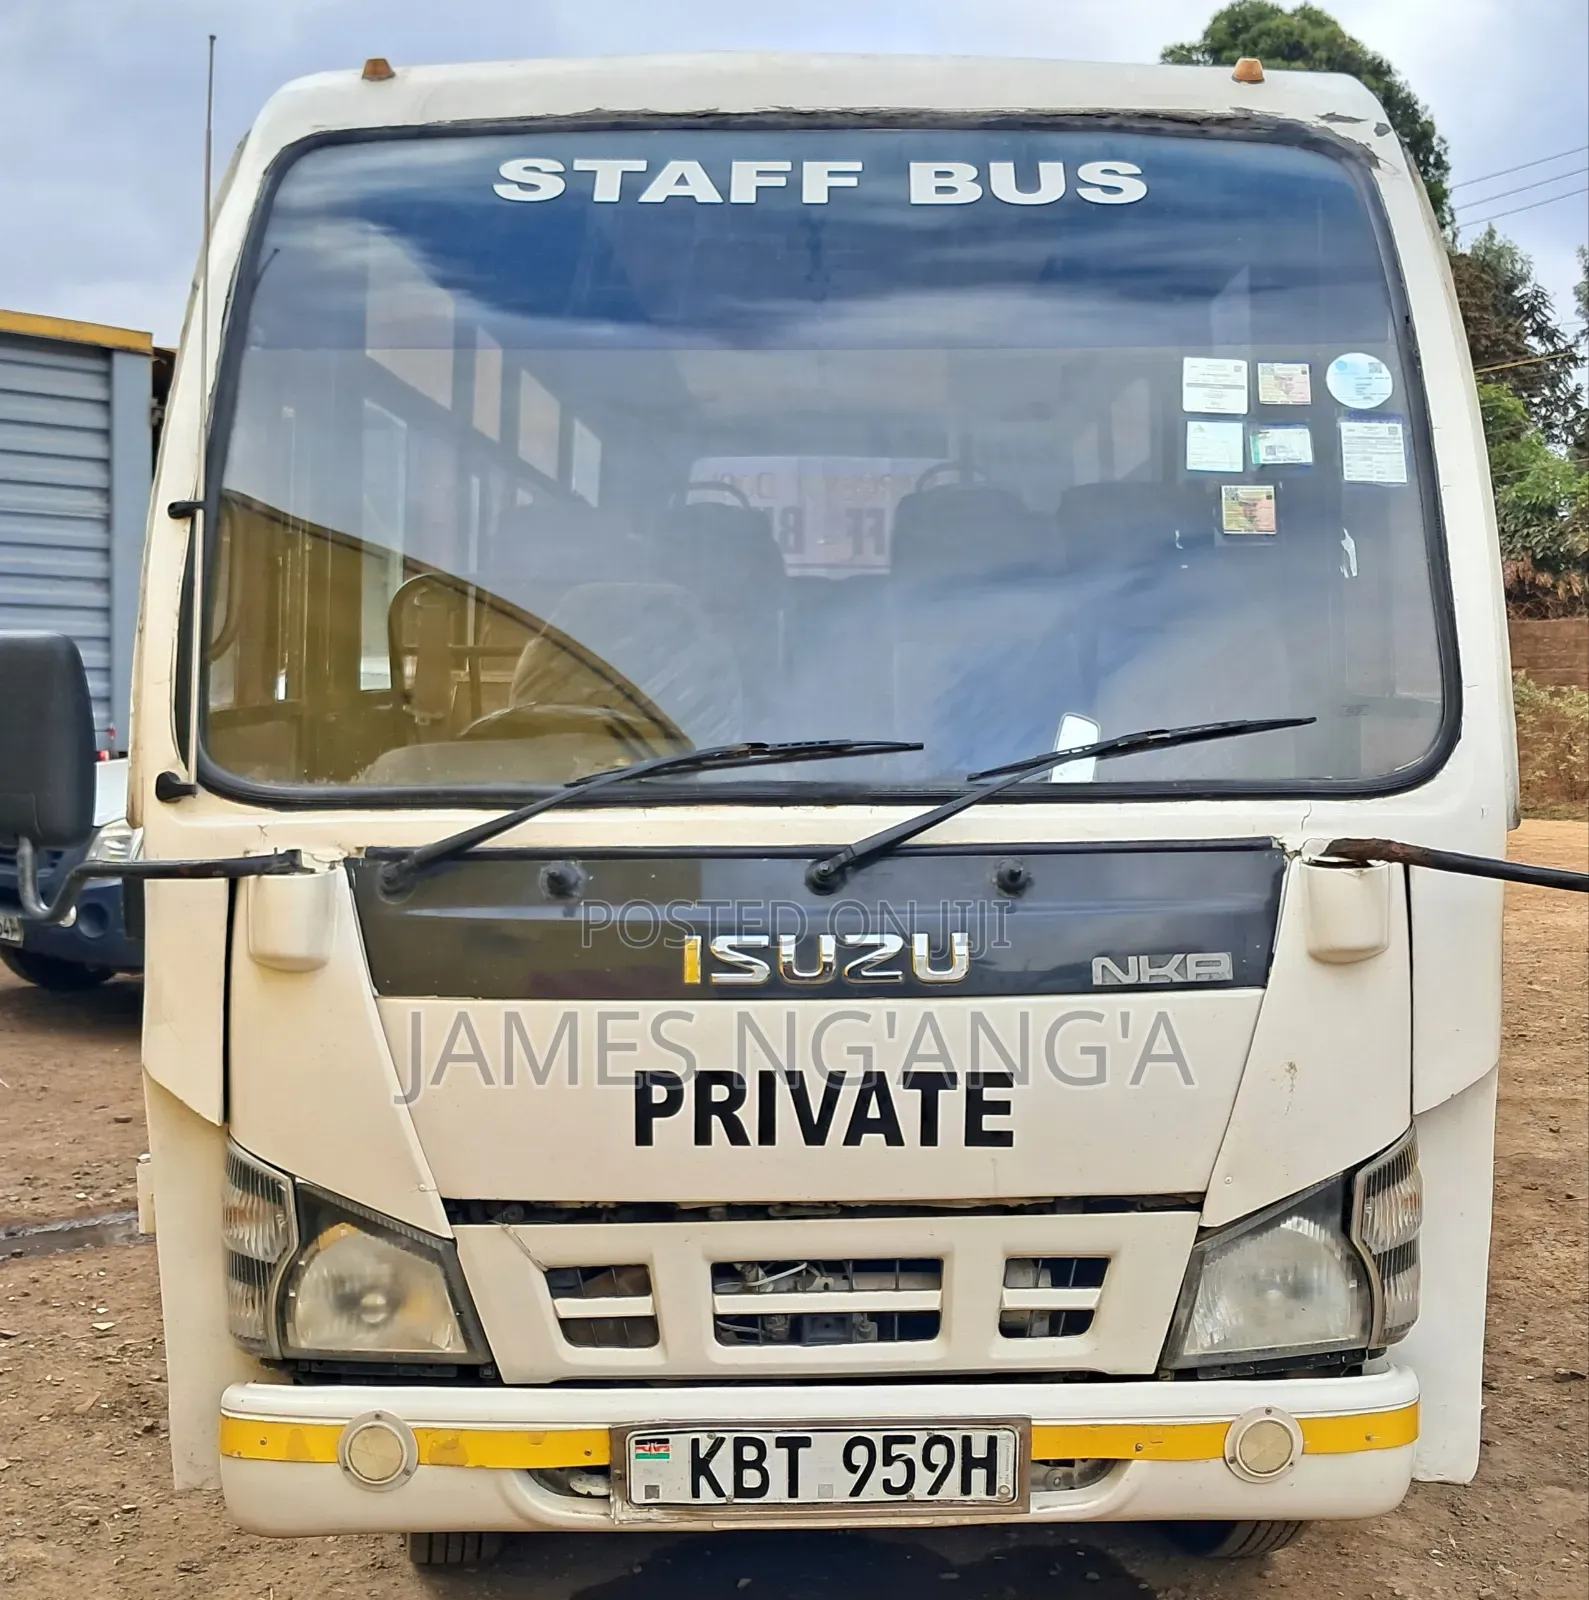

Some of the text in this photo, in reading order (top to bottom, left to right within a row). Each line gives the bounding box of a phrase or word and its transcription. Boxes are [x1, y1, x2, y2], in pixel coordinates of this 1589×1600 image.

[493, 158, 1149, 206] STAFF BUS
[683, 931, 971, 985] ISUZU
[634, 1069, 1014, 1147] PRIVATE
[690, 1436, 812, 1499] KBT
[842, 1434, 999, 1497] 959H
